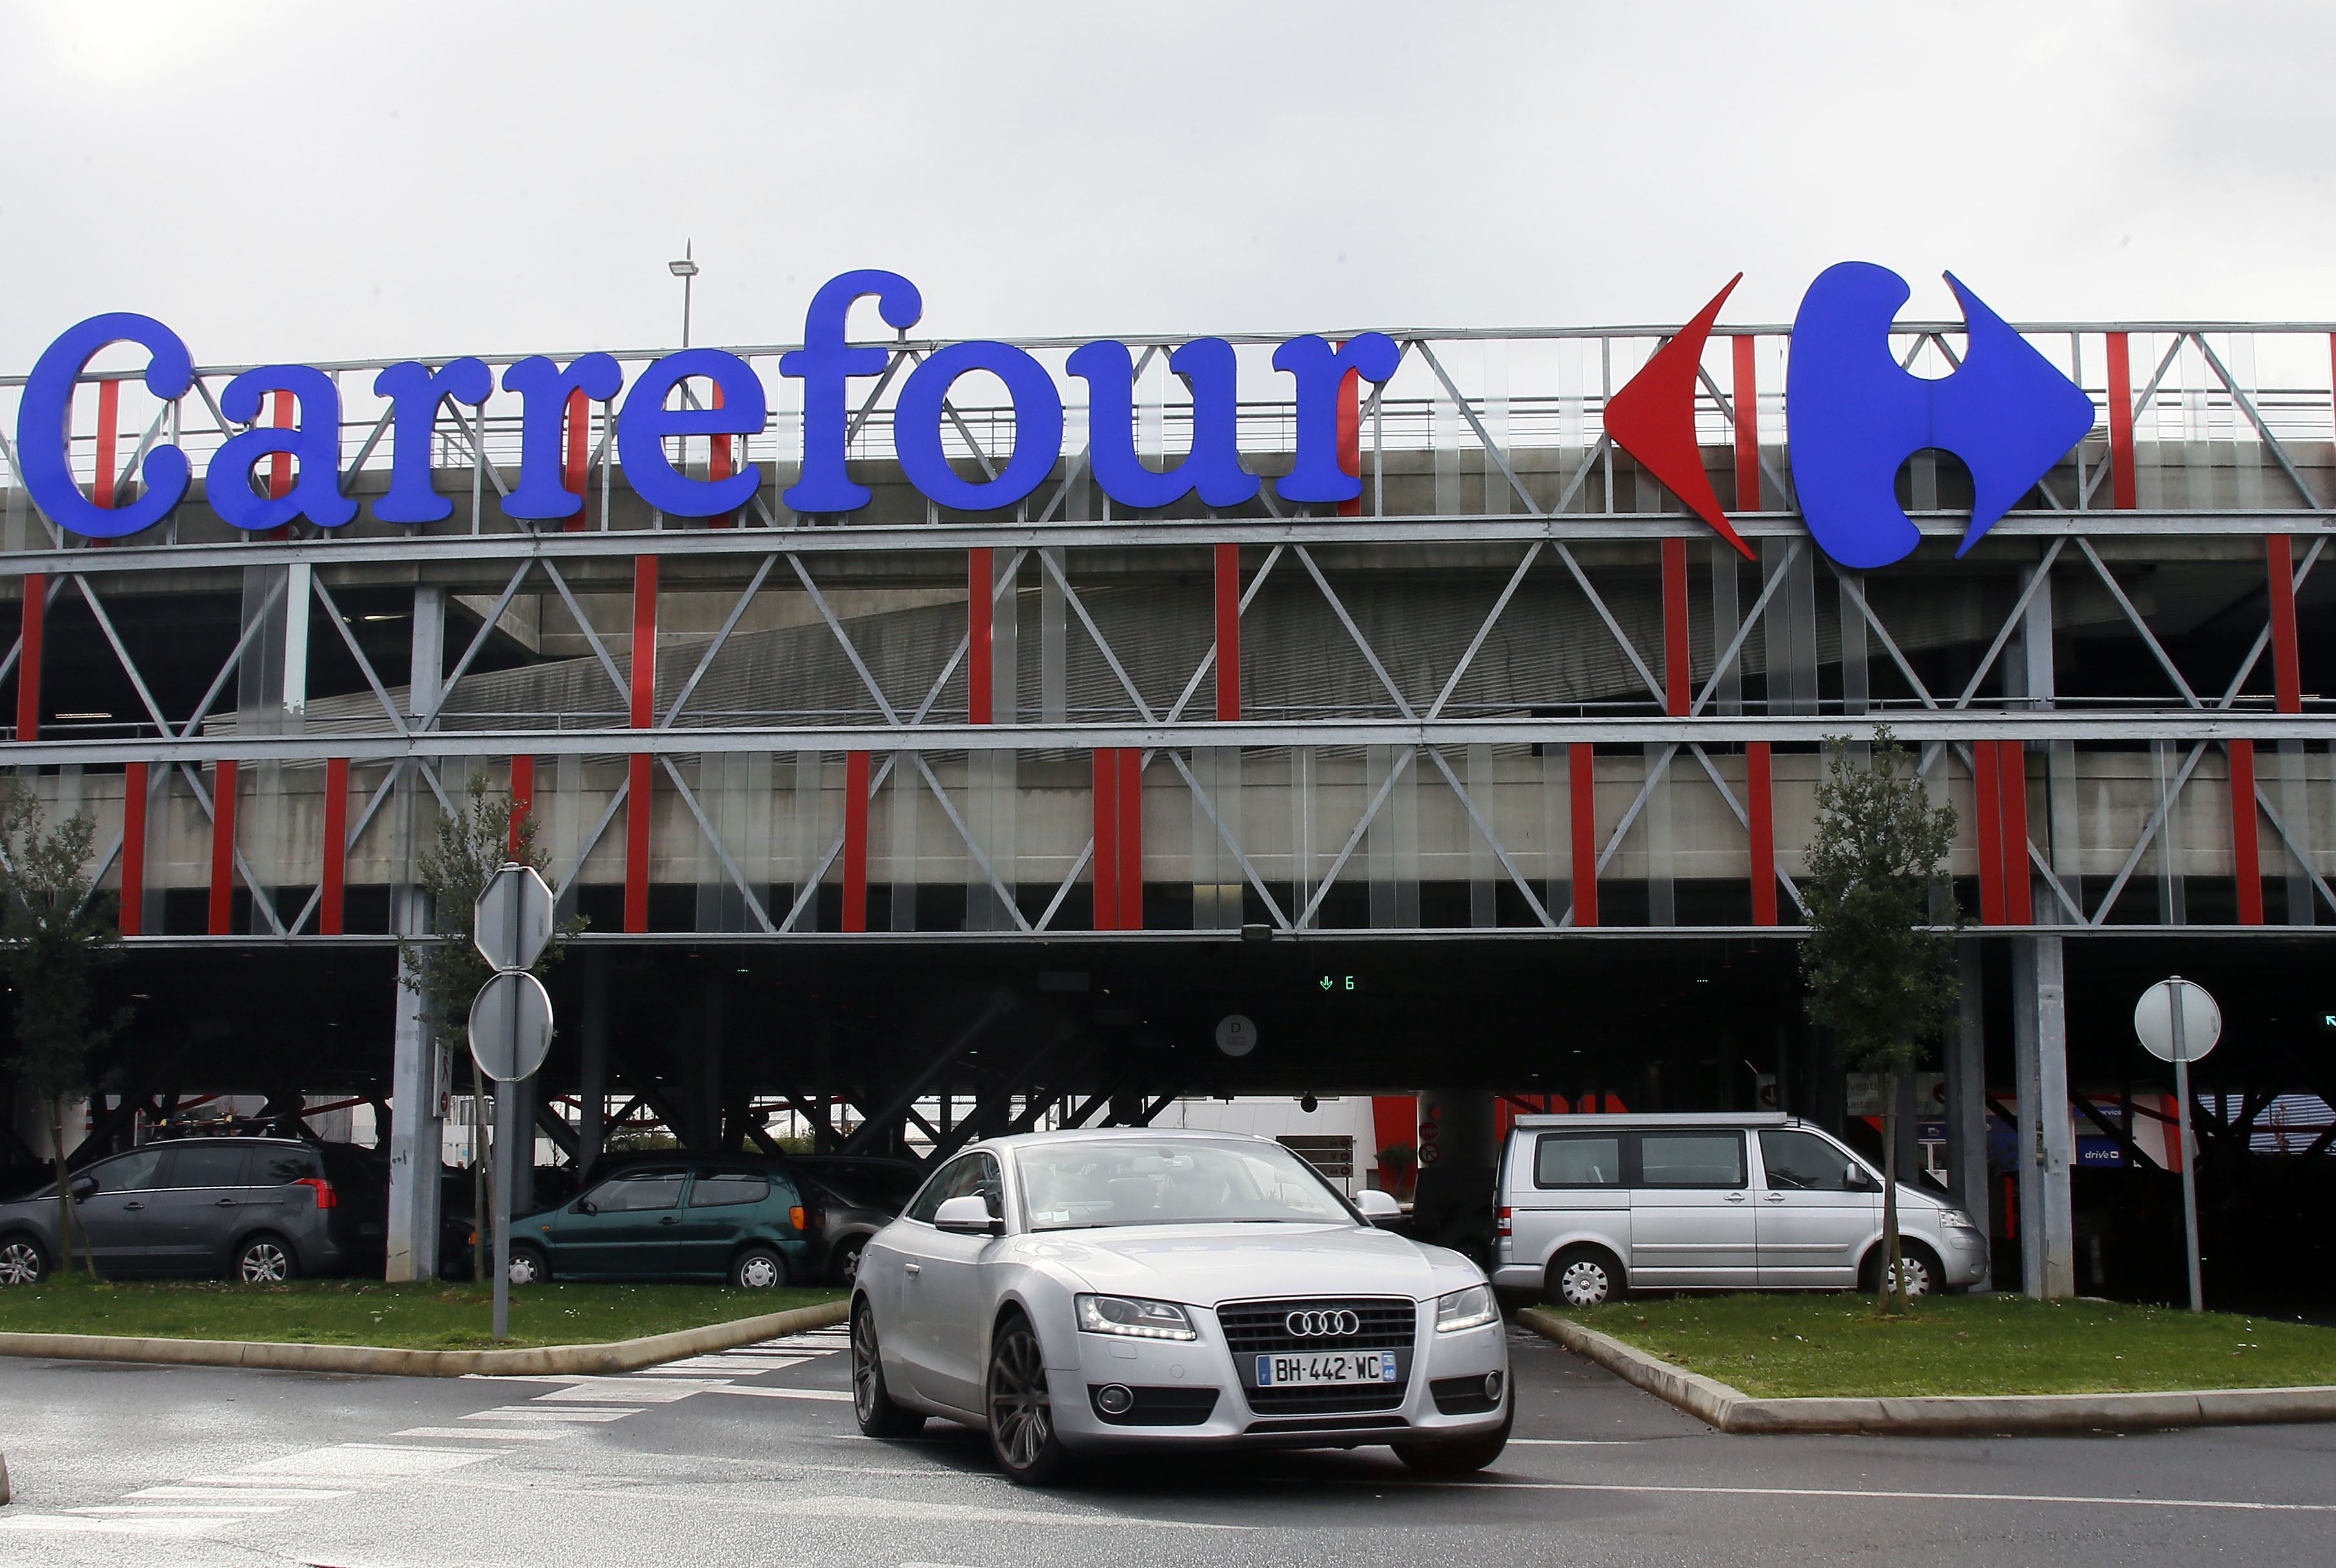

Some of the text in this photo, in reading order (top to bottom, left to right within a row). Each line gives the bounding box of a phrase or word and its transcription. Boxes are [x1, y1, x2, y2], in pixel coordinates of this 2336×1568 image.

[18, 270, 1400, 537] Carrefour
[1345, 976, 1354, 990] 6
[2085, 1150, 2109, 1159] drive
